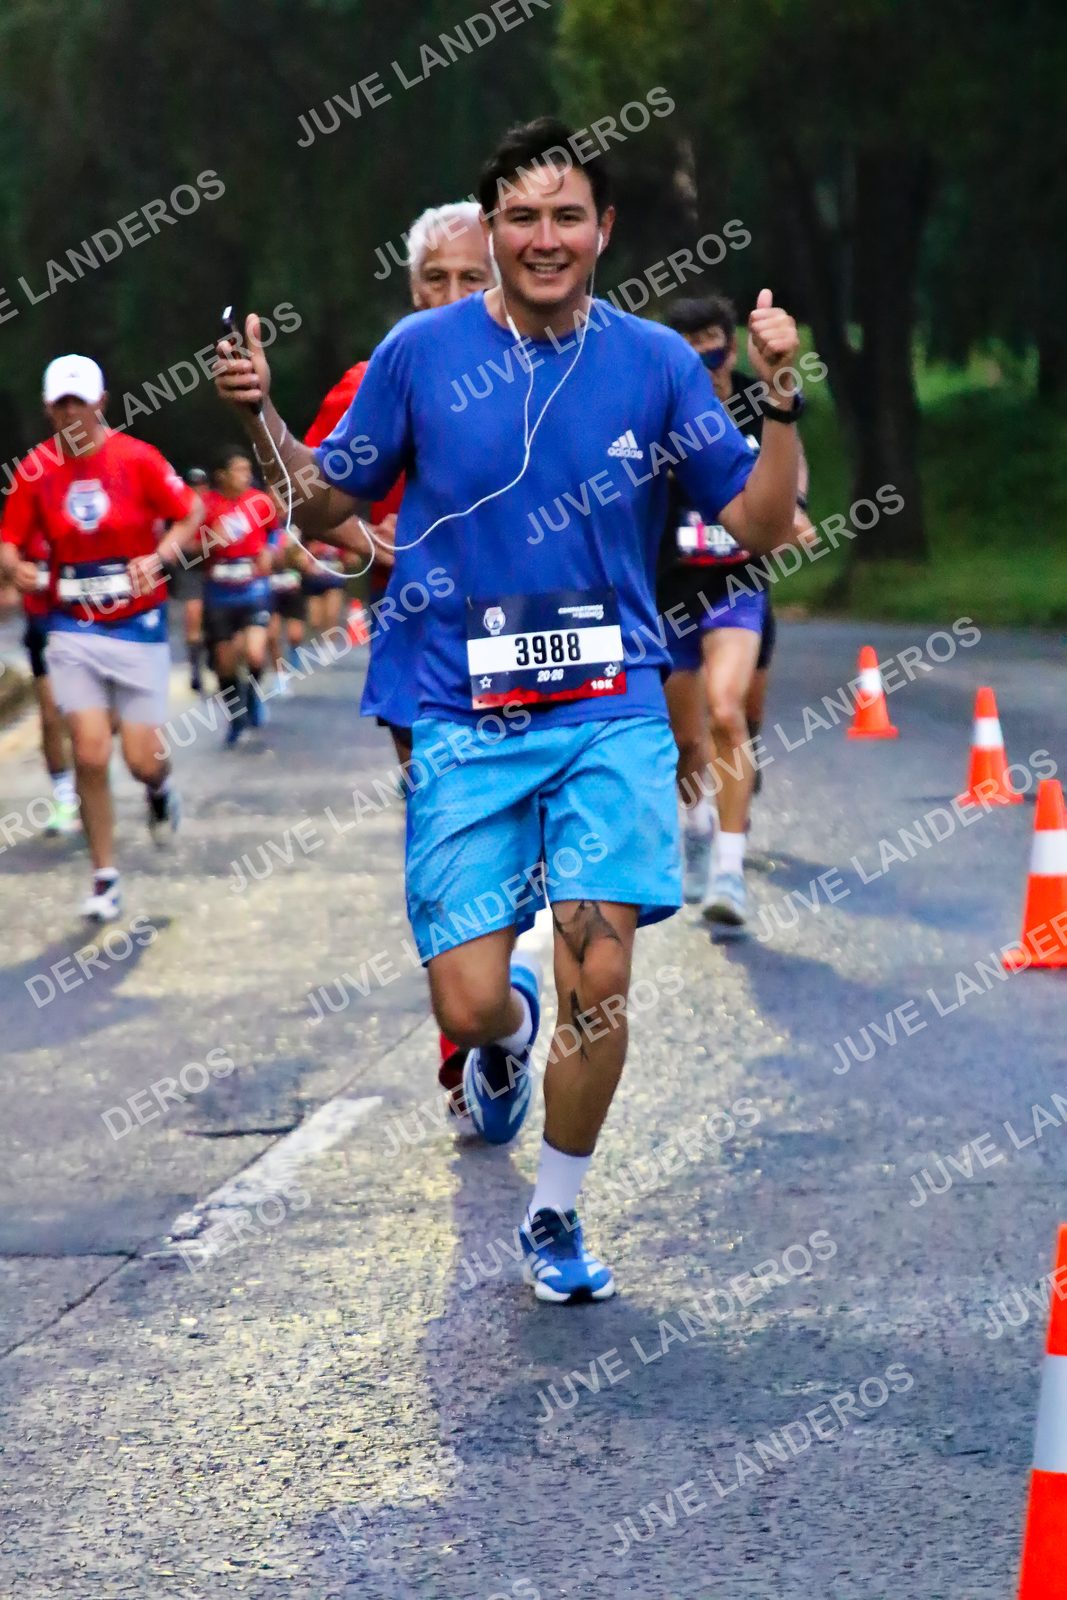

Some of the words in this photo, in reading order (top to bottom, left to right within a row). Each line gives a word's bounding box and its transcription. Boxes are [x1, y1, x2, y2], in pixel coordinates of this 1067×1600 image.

[608, 446, 643, 459] adidas
[515, 632, 581, 666] 3988
[591, 679, 614, 690] 10K
